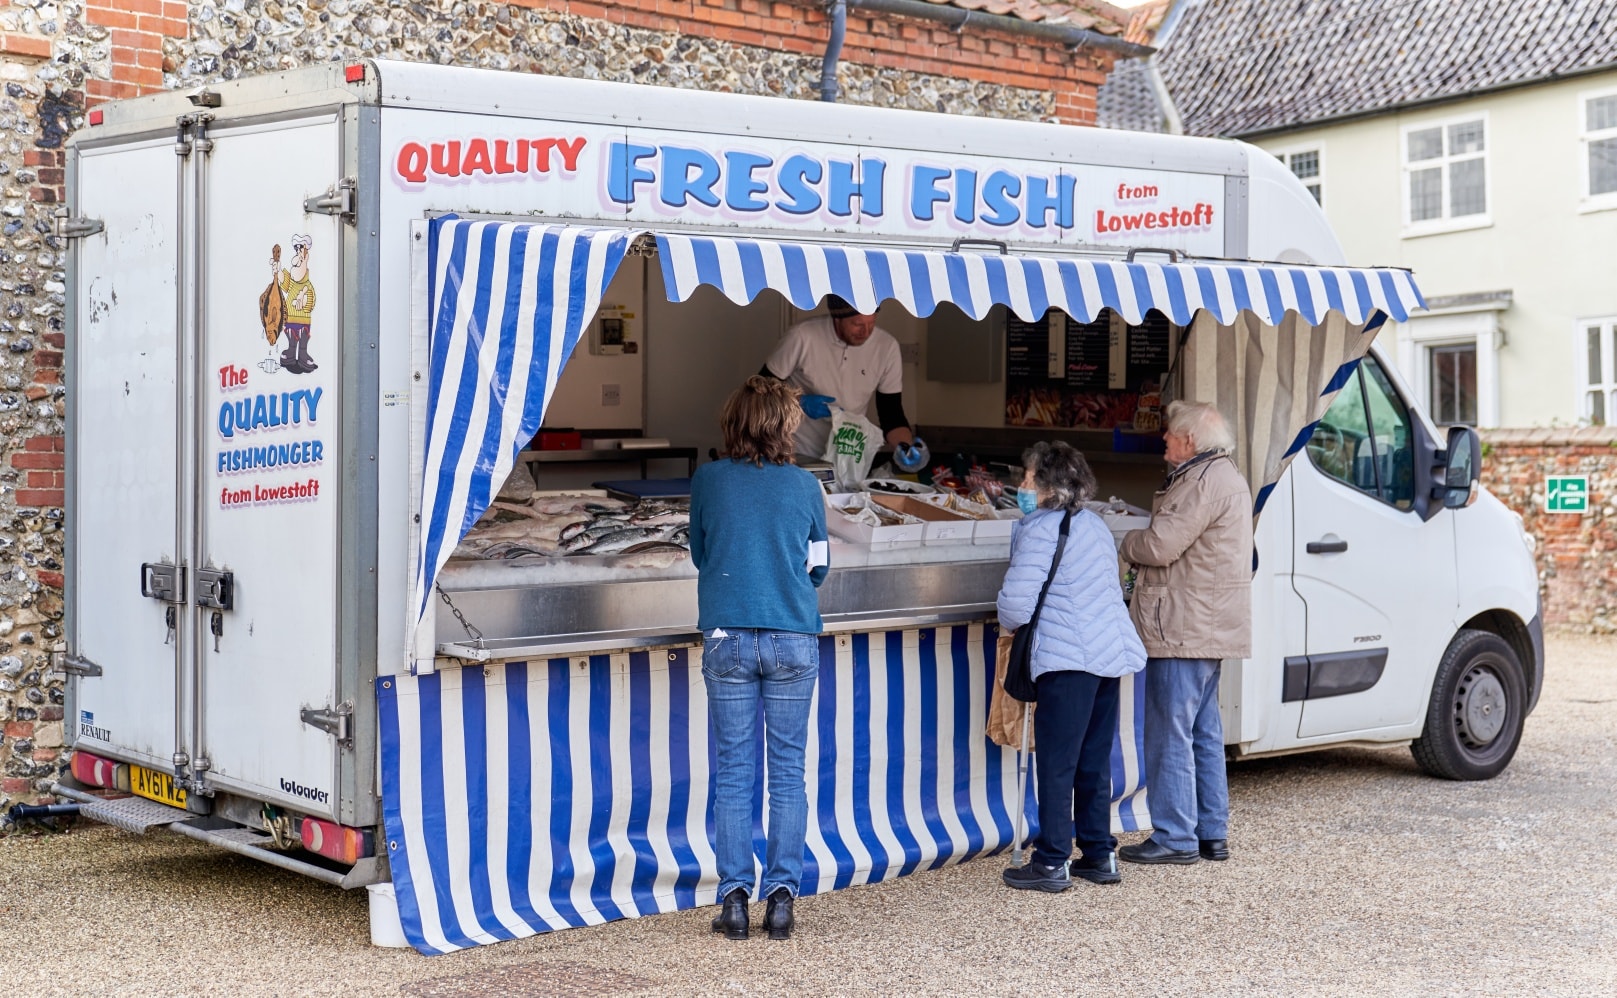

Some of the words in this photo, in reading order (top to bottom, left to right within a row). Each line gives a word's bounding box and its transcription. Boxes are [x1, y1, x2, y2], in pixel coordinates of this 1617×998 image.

[396, 136, 588, 184] QUALITY
[606, 140, 887, 218] FRESH
[910, 162, 1078, 229] FISH
[1117, 182, 1159, 200] from
[1096, 202, 1214, 233] Lowestoft
[219, 364, 249, 388] The
[218, 386, 324, 438] QUALITY
[217, 439, 324, 473] FISHMONGER
[221, 487, 252, 505] from
[254, 478, 320, 502] Lowestoft
[80, 723, 112, 742] RENAULT
[138, 767, 164, 798] AY61
[280, 777, 329, 804] loloader
